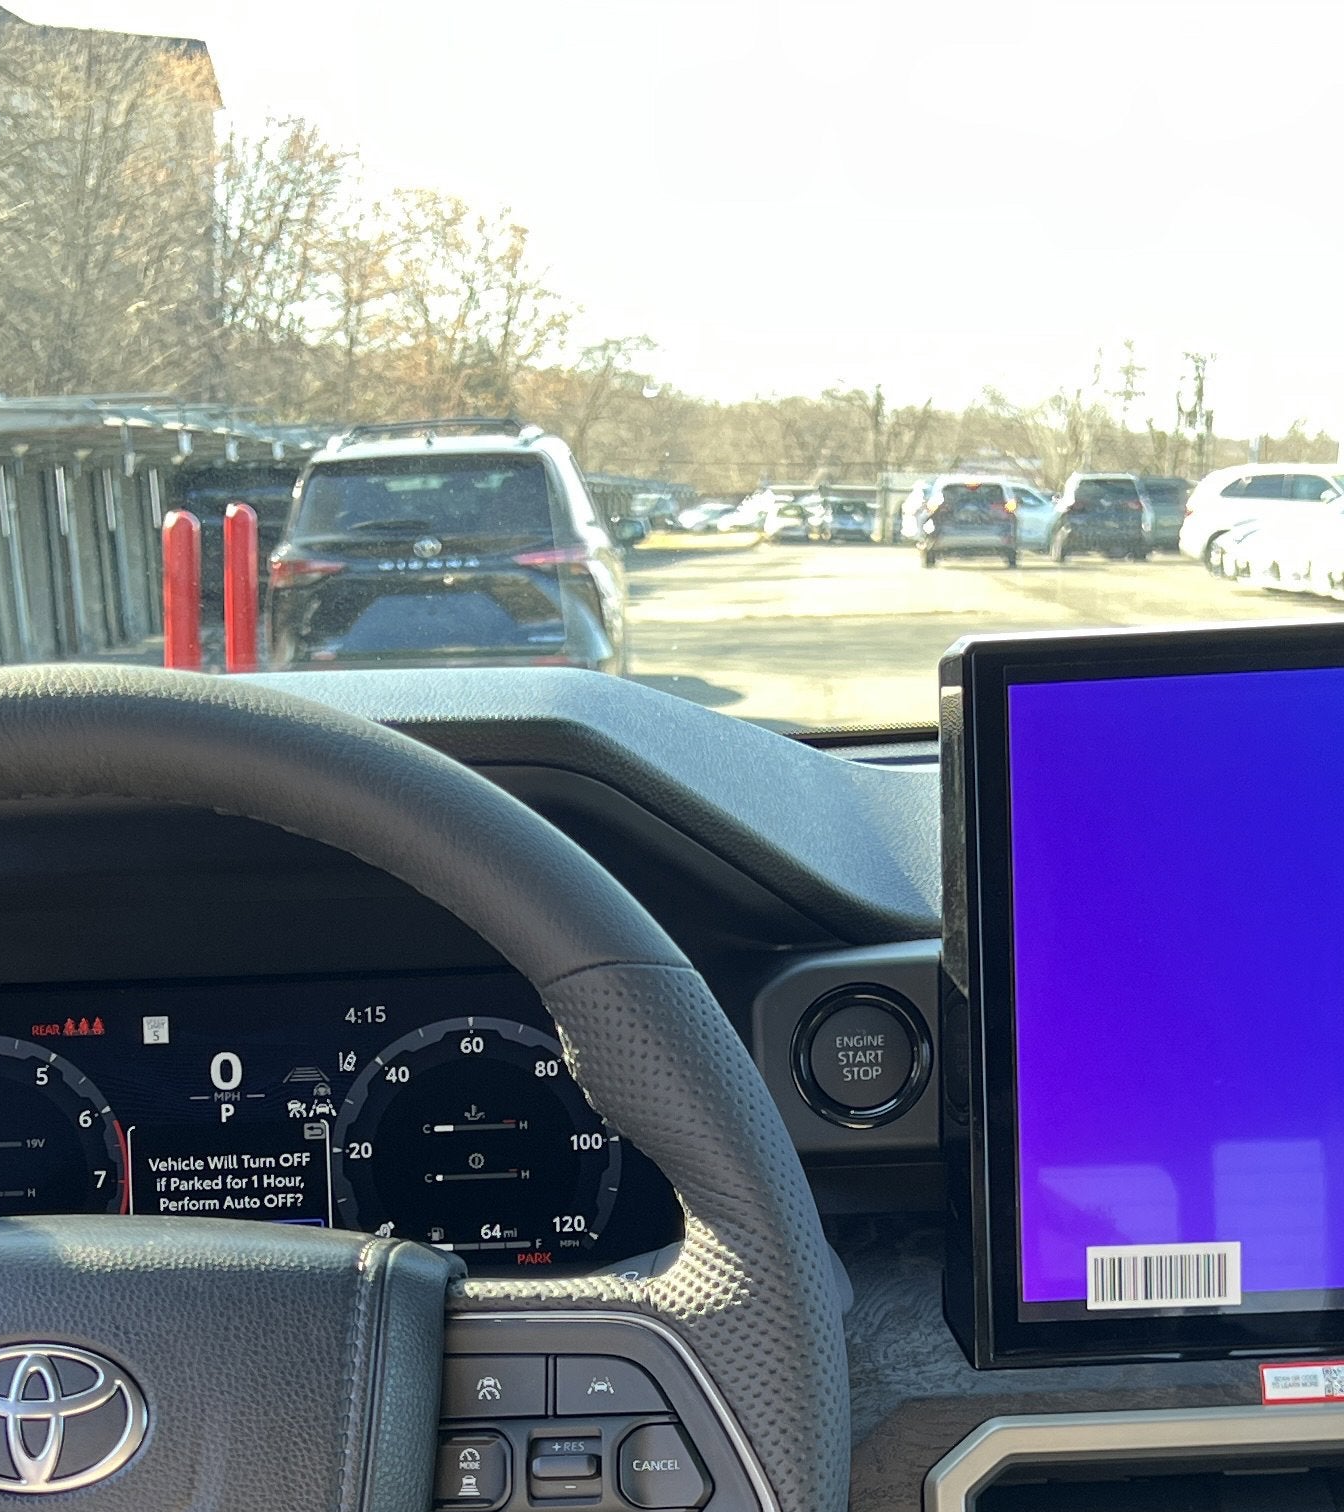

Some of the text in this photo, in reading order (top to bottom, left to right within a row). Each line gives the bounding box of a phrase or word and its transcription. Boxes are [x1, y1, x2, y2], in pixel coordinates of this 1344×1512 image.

[344, 1006, 386, 1024] 4:15
[31, 1024, 61, 1037] REAR
[152, 1031, 161, 1042] 5
[460, 1037, 484, 1054] 60
[835, 1034, 885, 1049] ENGINE
[837, 1050, 884, 1066] START
[35, 1067, 49, 1085] 5
[210, 1051, 243, 1091] 0
[386, 1067, 410, 1083] 40
[534, 1060, 559, 1077] 80
[842, 1066, 882, 1082] STOP
[213, 1091, 241, 1102] MPH
[78, 1110, 92, 1128] 6
[220, 1103, 235, 1123] P
[422, 1124, 432, 1135] C
[519, 1120, 529, 1130] H
[25, 1138, 46, 1149] 19V
[570, 1133, 603, 1150] 100
[348, 1142, 372, 1159] 20
[148, 1152, 311, 1173] Vehicle Will Turn OFF
[93, 1170, 107, 1189] 7
[156, 1173, 305, 1192] if Parked for 1 Hour,
[424, 1173, 434, 1184] C
[521, 1169, 530, 1180] H
[27, 1188, 36, 1198] H
[159, 1194, 304, 1212] Perform Auto OFF?
[480, 1224, 518, 1239] 64 mi
[552, 1215, 585, 1232] 120
[535, 1239, 543, 1249] F
[559, 1239, 580, 1248] MPH
[517, 1252, 552, 1265] PARK
[458, 1461, 481, 1470] MODE
[632, 1459, 681, 1472] CANCEL
